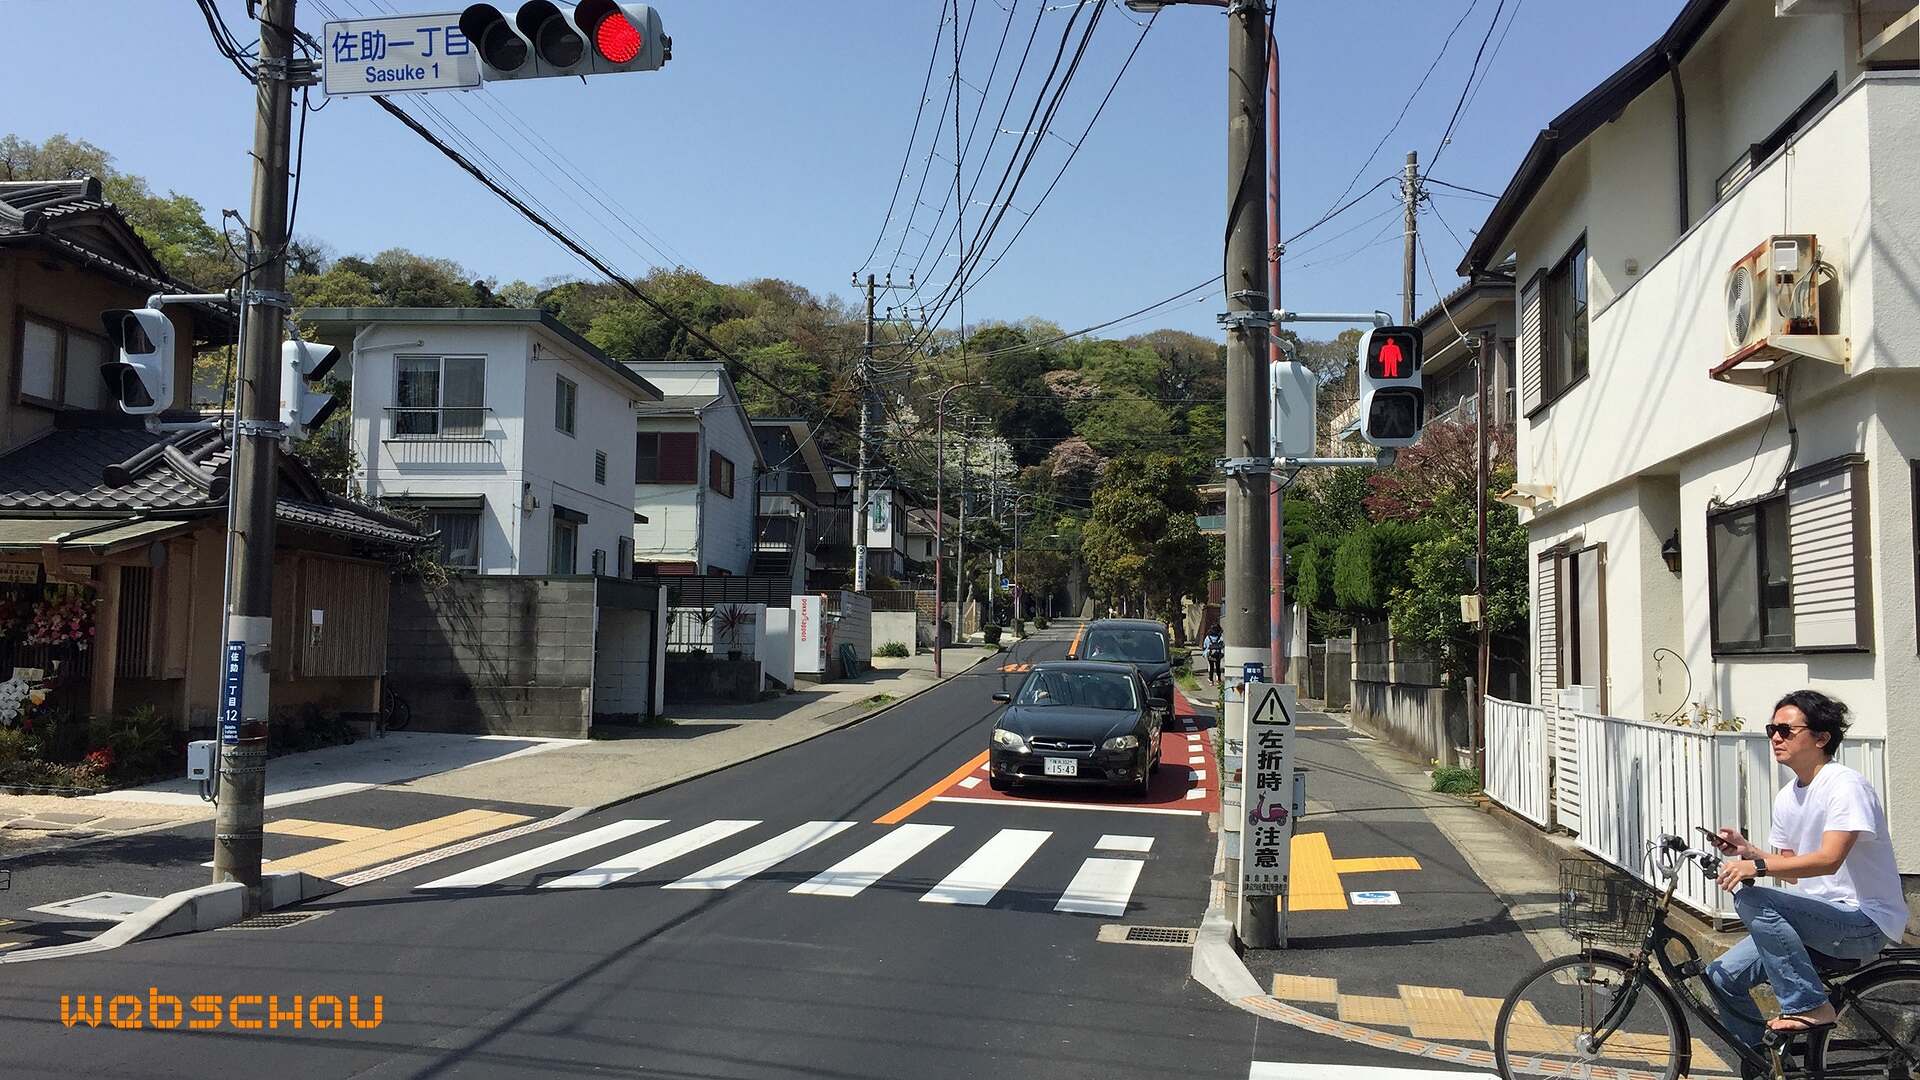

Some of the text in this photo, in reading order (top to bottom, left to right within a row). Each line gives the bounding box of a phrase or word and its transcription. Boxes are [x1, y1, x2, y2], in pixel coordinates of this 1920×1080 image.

[332, 25, 470, 63] 佐助一丁目
[365, 62, 440, 83] Sasuke 1
[226, 709, 238, 721] 12
[1256, 730, 1284, 792] 左折時
[1255, 826, 1281, 868] 注意
